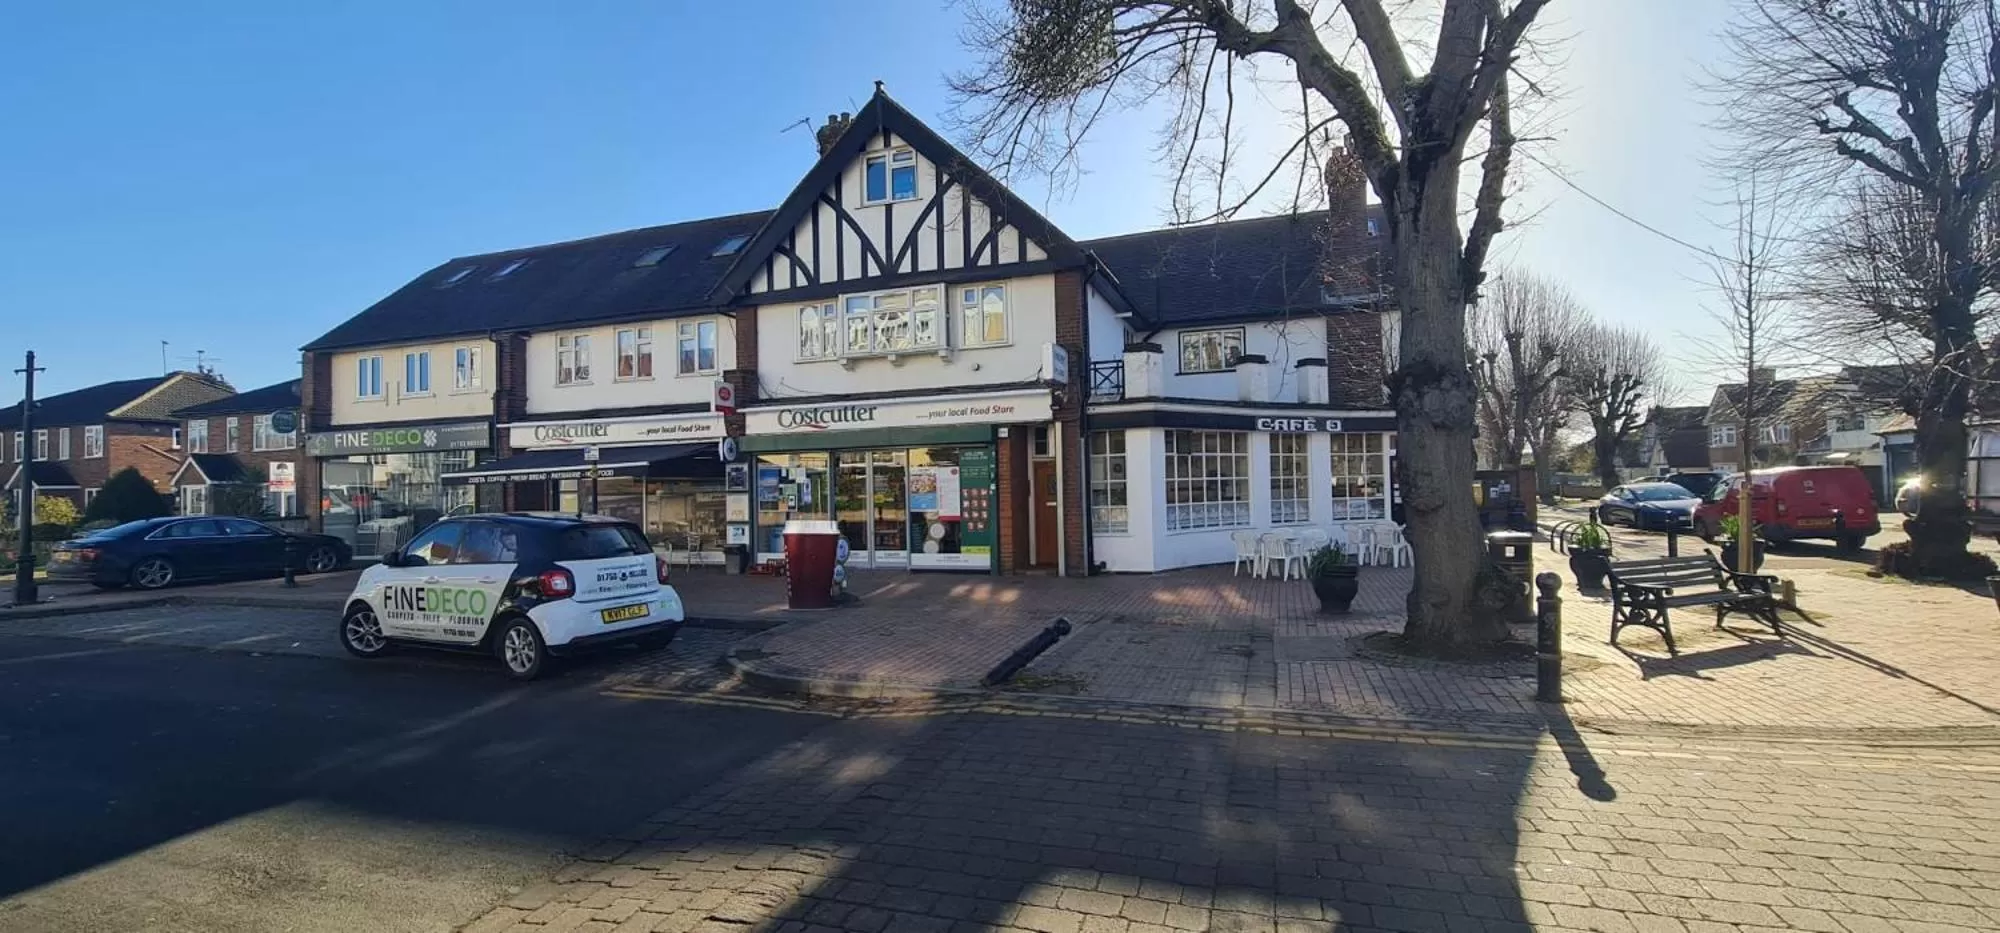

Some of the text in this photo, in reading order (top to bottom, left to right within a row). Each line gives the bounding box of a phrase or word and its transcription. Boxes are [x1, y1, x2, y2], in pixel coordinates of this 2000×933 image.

[777, 405, 877, 429] Costcutter
[948, 407, 968, 417] local
[970, 405, 990, 415] Food
[991, 404, 1015, 414] Store
[334, 429, 422, 448] FINE DECO
[534, 423, 610, 441] Costcutter
[678, 424, 693, 432] Food
